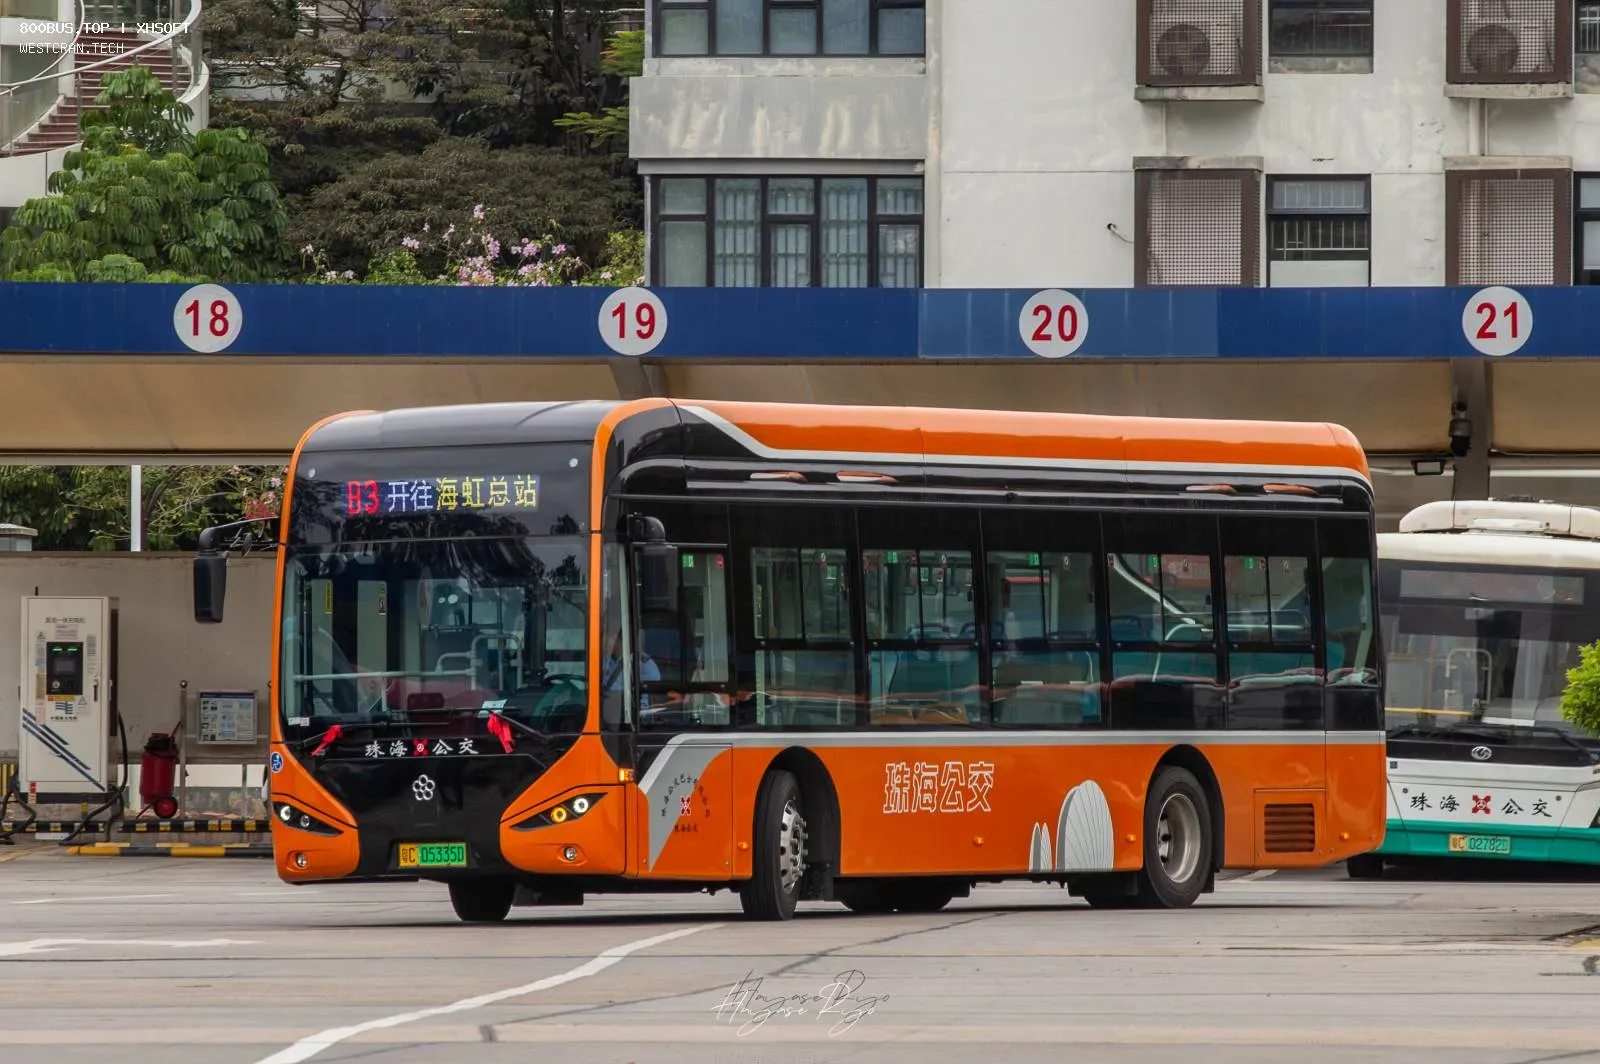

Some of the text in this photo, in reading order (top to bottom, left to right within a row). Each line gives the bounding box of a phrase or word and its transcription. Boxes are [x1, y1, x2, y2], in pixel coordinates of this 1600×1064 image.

[185, 299, 229, 337] 18
[612, 301, 656, 340] 19
[1031, 304, 1078, 342] 20
[1475, 301, 1518, 339] 21
[387, 474, 537, 513] 开往海虹总站
[364, 738, 479, 758] 珠海 公交
[882, 761, 995, 814] 珠海公交
[1409, 792, 1553, 818] 珠海 公交
